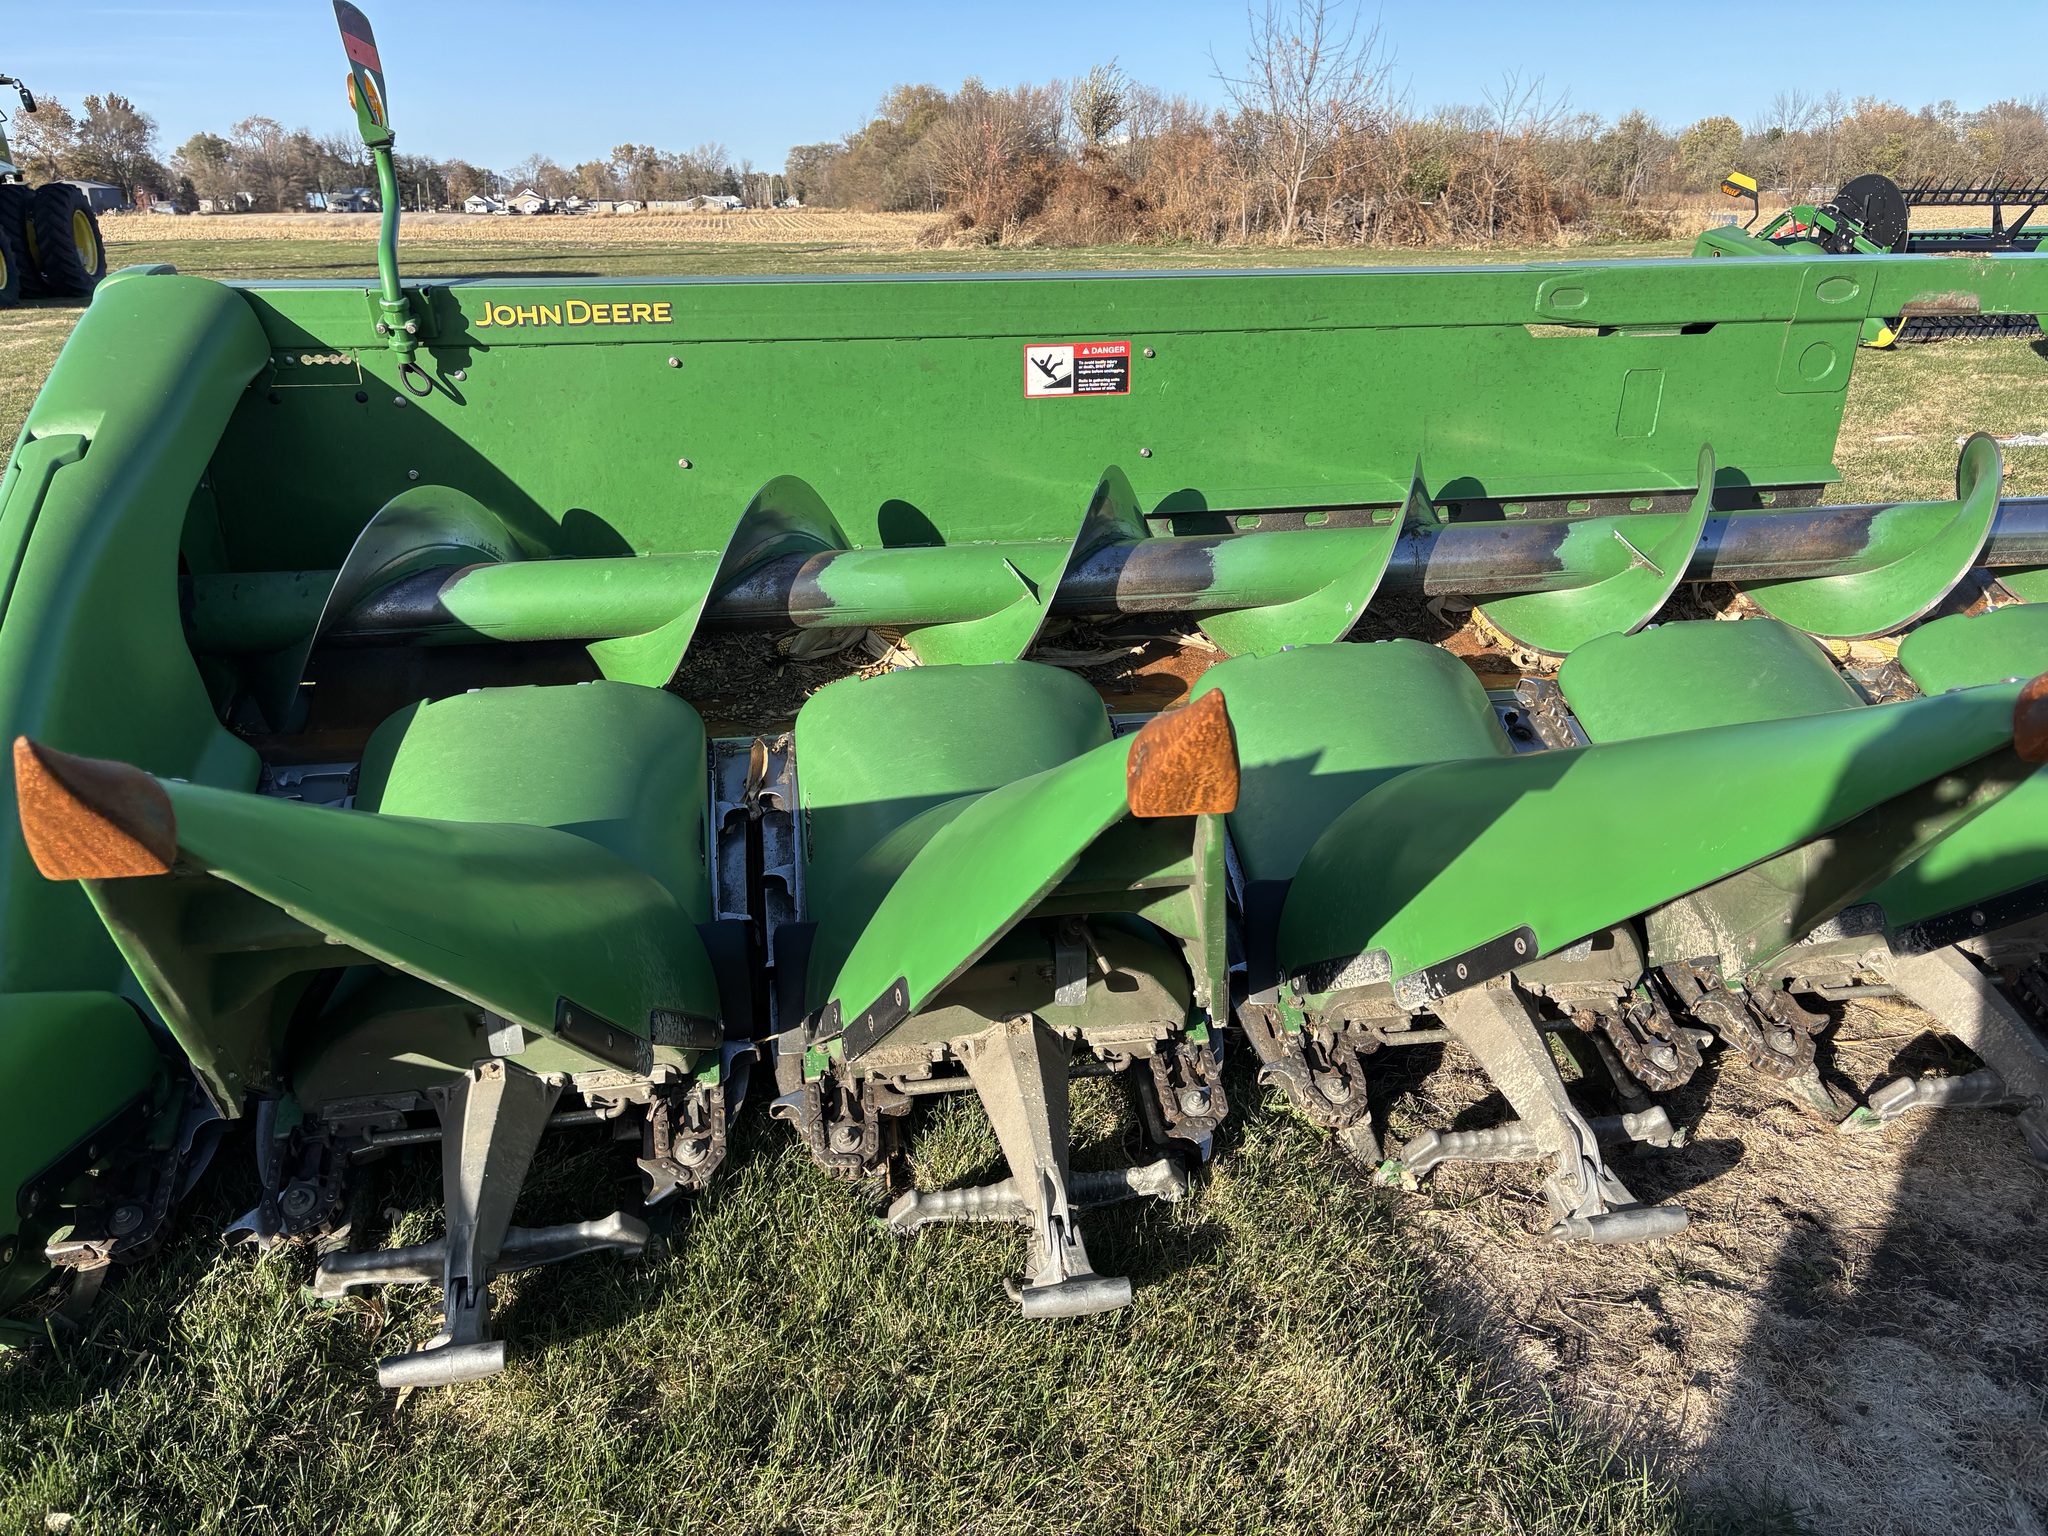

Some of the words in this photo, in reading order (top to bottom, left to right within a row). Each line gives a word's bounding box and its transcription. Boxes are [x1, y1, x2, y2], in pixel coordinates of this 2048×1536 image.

[475, 301, 563, 327] JOHN
[565, 299, 673, 326] DEERE
[1091, 346, 1125, 354] DANGER
